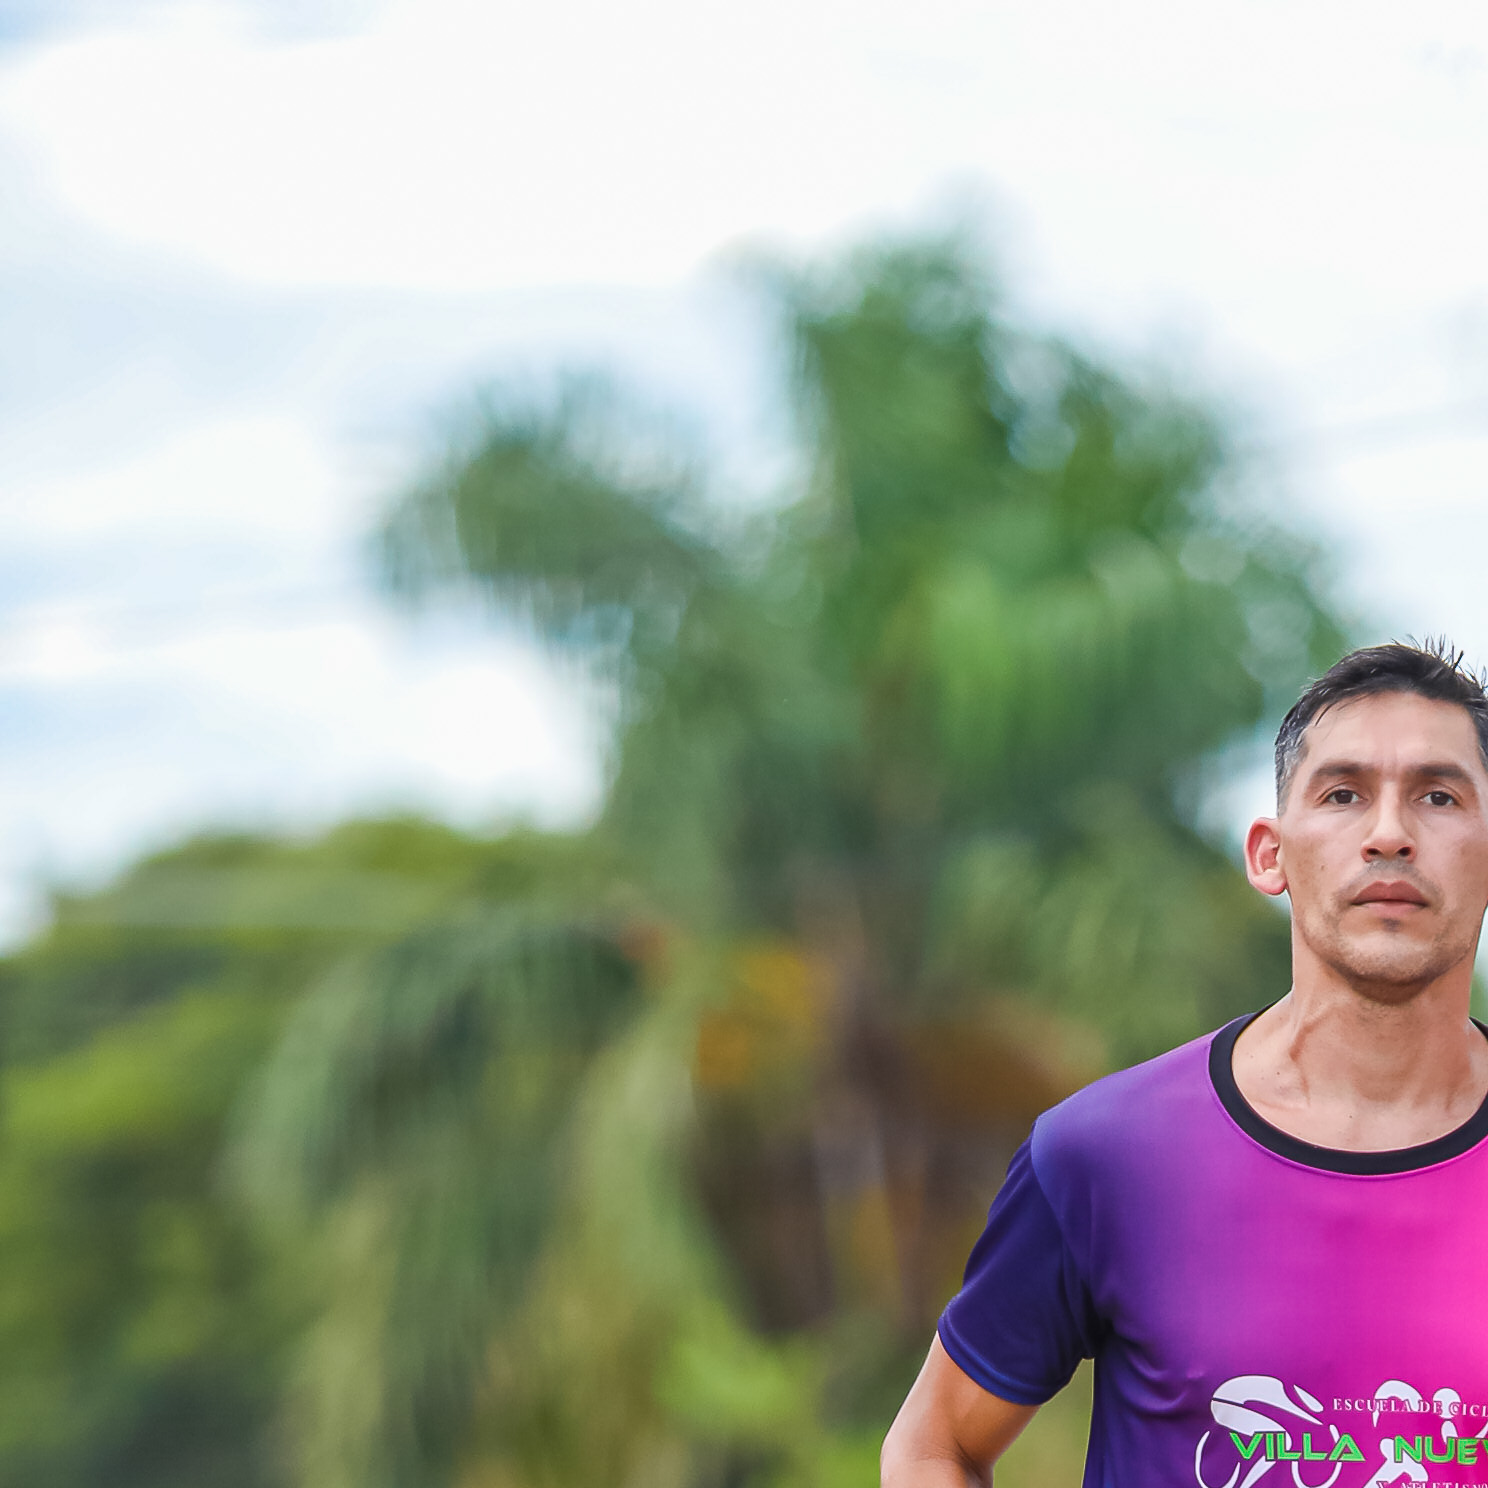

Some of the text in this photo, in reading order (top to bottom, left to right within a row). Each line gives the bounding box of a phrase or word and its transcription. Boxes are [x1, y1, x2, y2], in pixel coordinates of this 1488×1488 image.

[1333, 1398, 1412, 1412] ESCUELA
[1420, 1401, 1442, 1414] DE
[1229, 1432, 1366, 1462] VILLA
